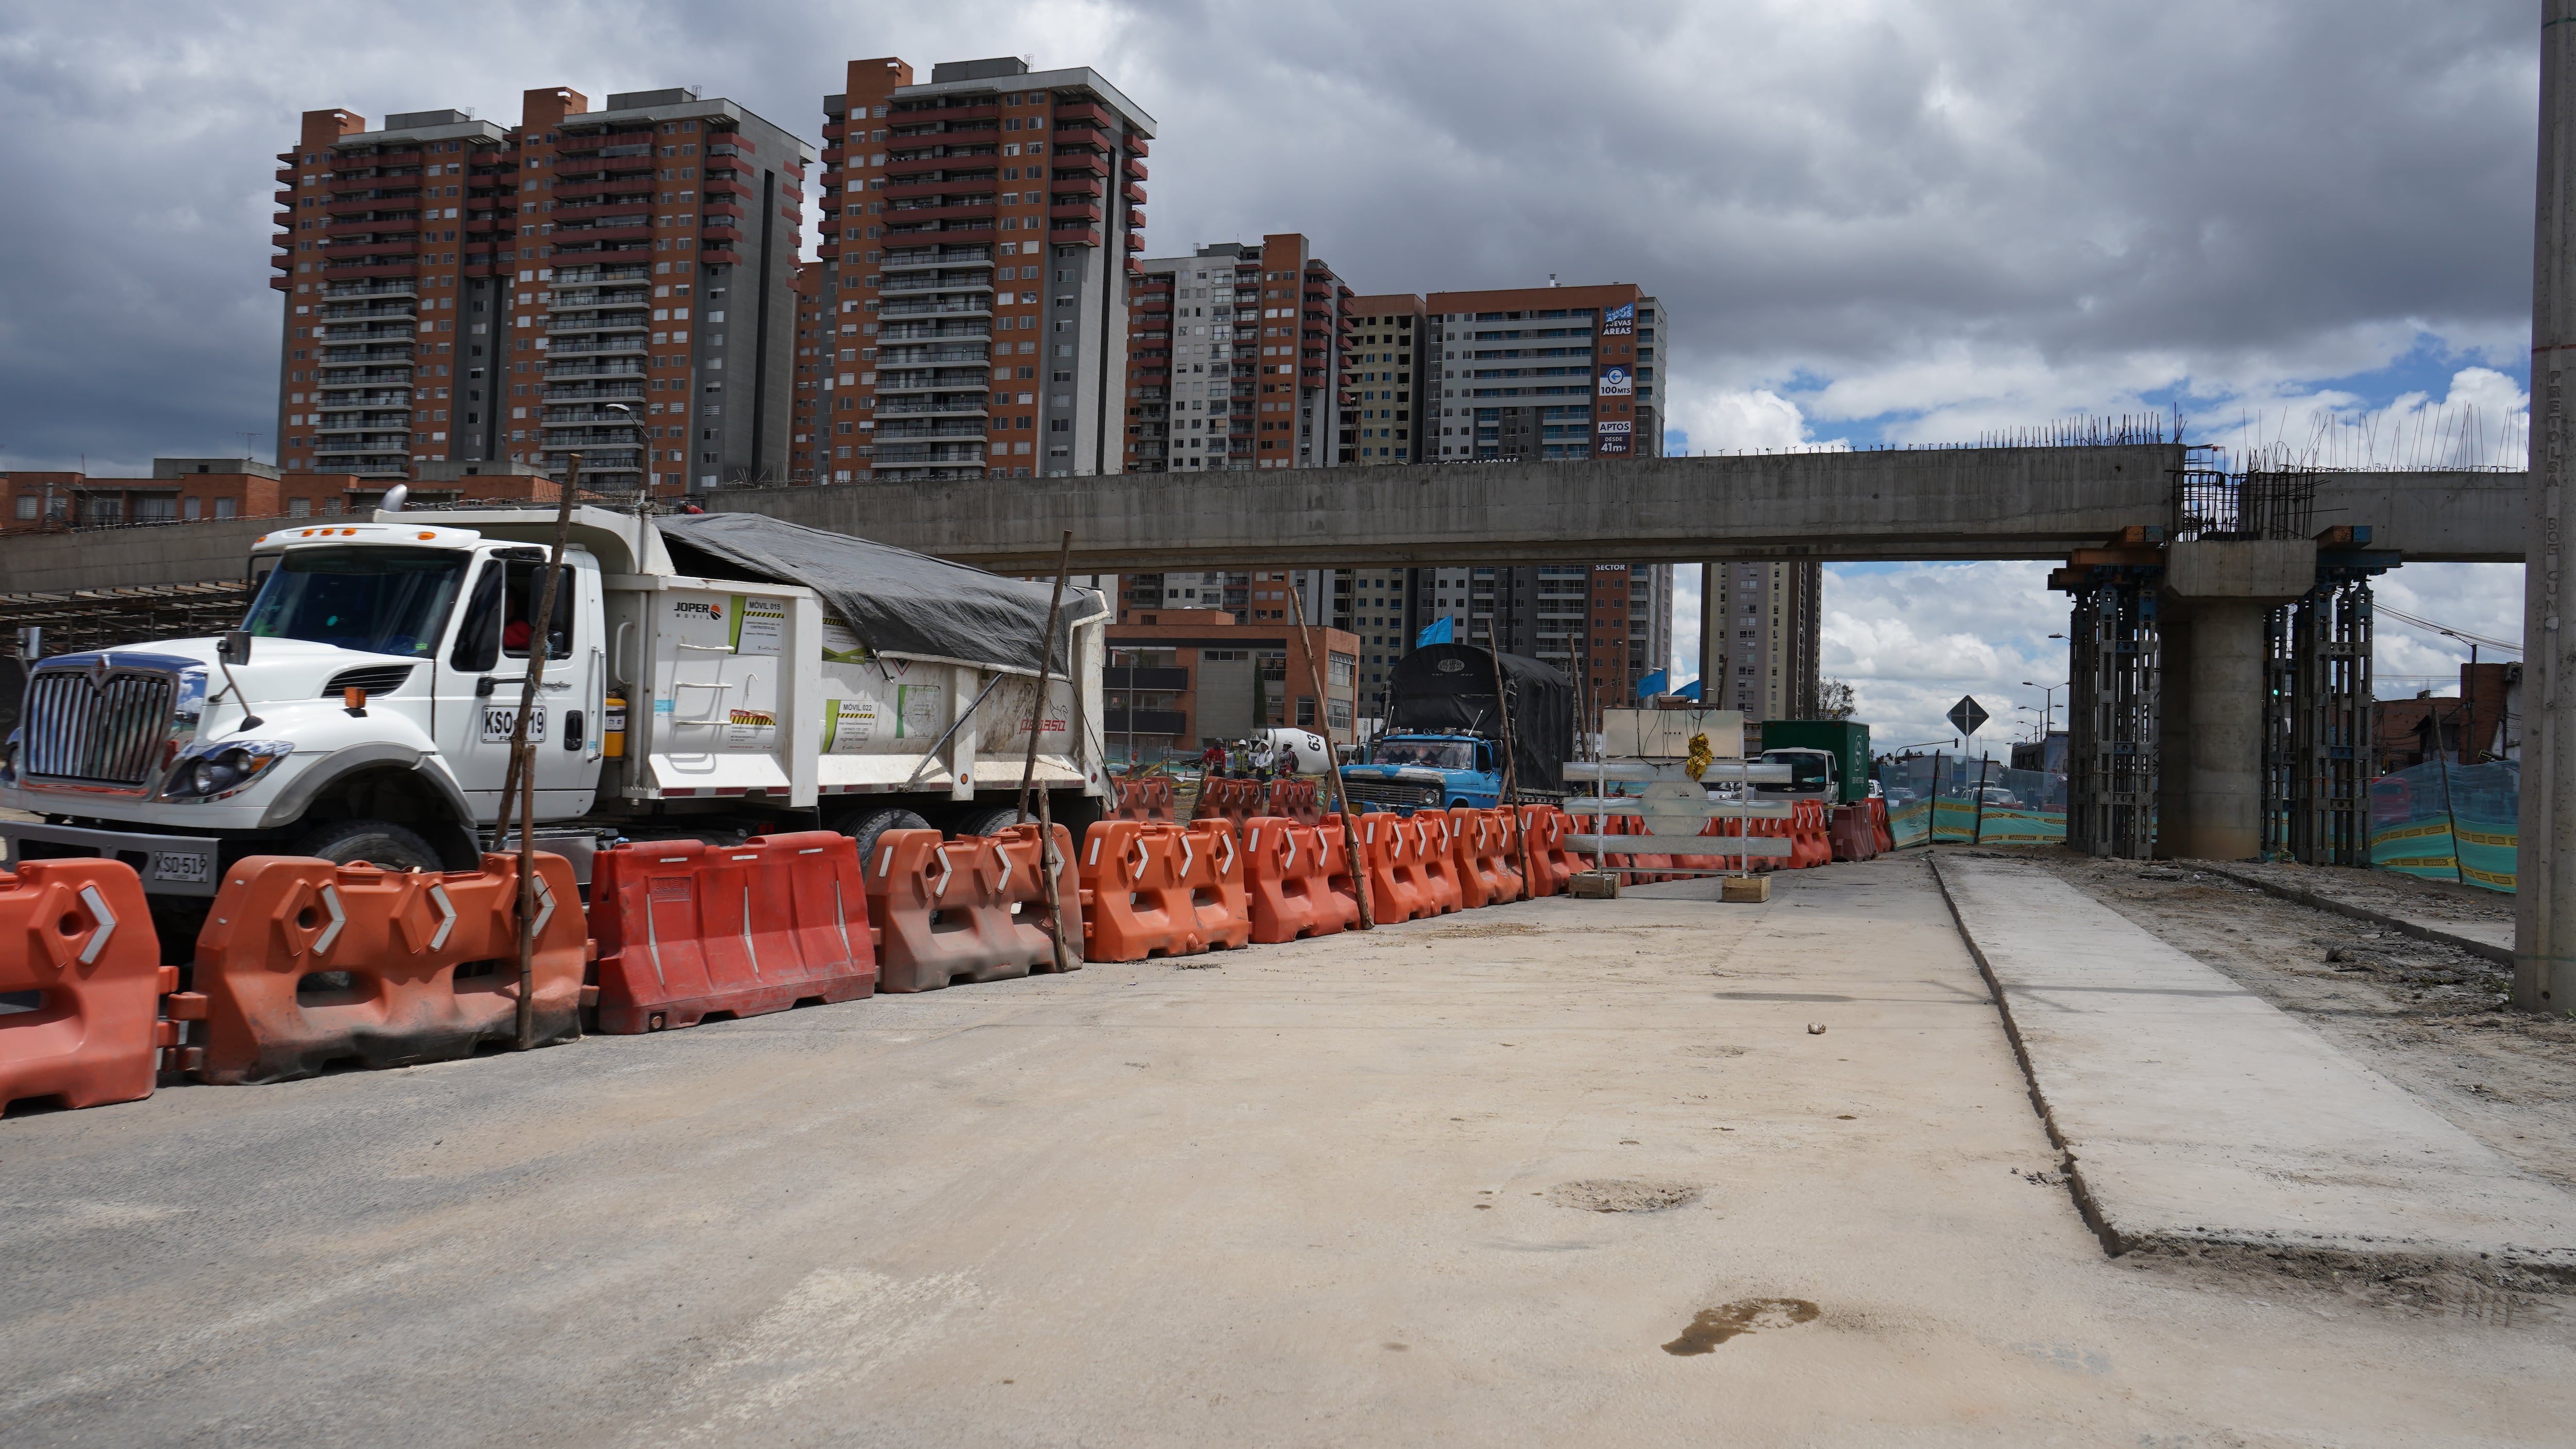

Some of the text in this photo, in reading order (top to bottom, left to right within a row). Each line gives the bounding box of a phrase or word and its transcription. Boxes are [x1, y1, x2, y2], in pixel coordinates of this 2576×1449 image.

[1600, 423, 1629, 431] APTOS
[674, 602, 709, 613] JOPER
[1307, 734, 1320, 752] 63
